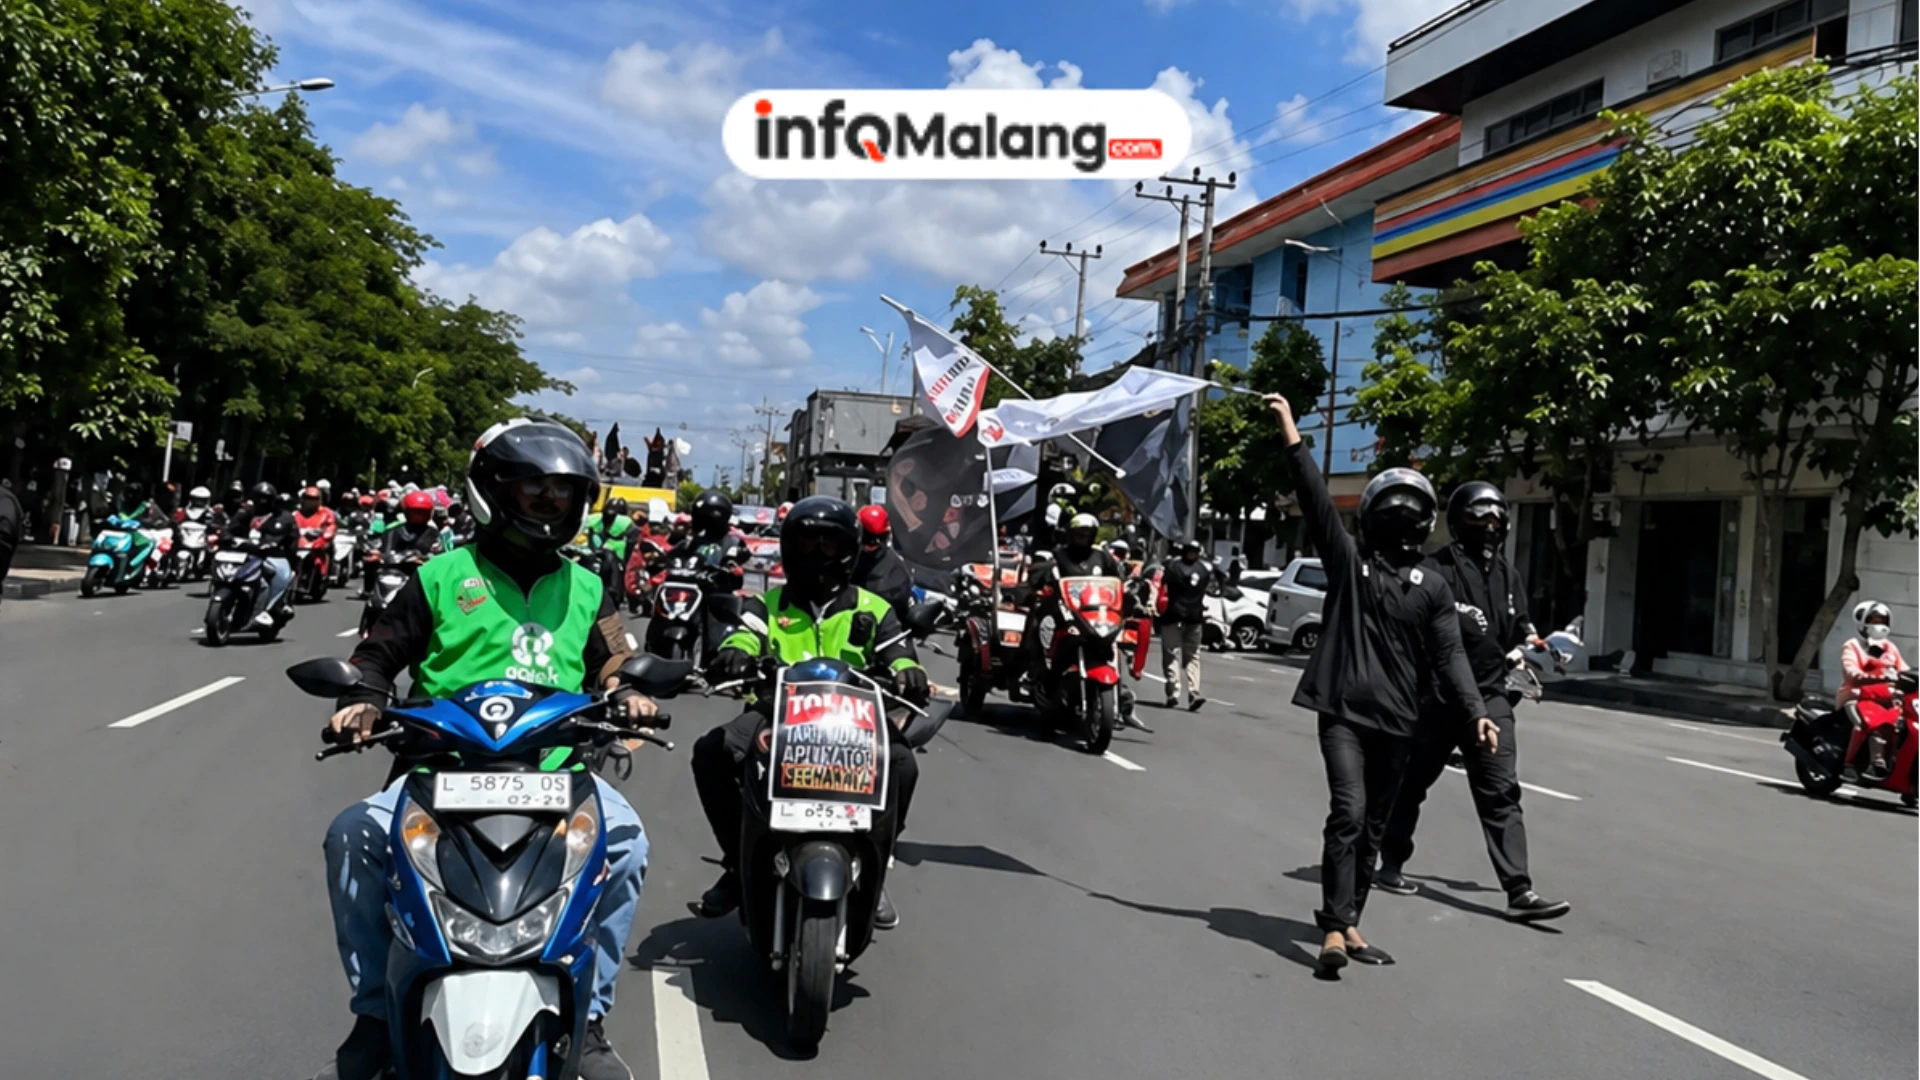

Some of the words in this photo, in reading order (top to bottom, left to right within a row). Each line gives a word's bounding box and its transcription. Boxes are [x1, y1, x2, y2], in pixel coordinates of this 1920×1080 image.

[788, 693, 873, 723] TOLAK
[443, 777, 454, 791] L
[470, 775, 525, 792] 5875
